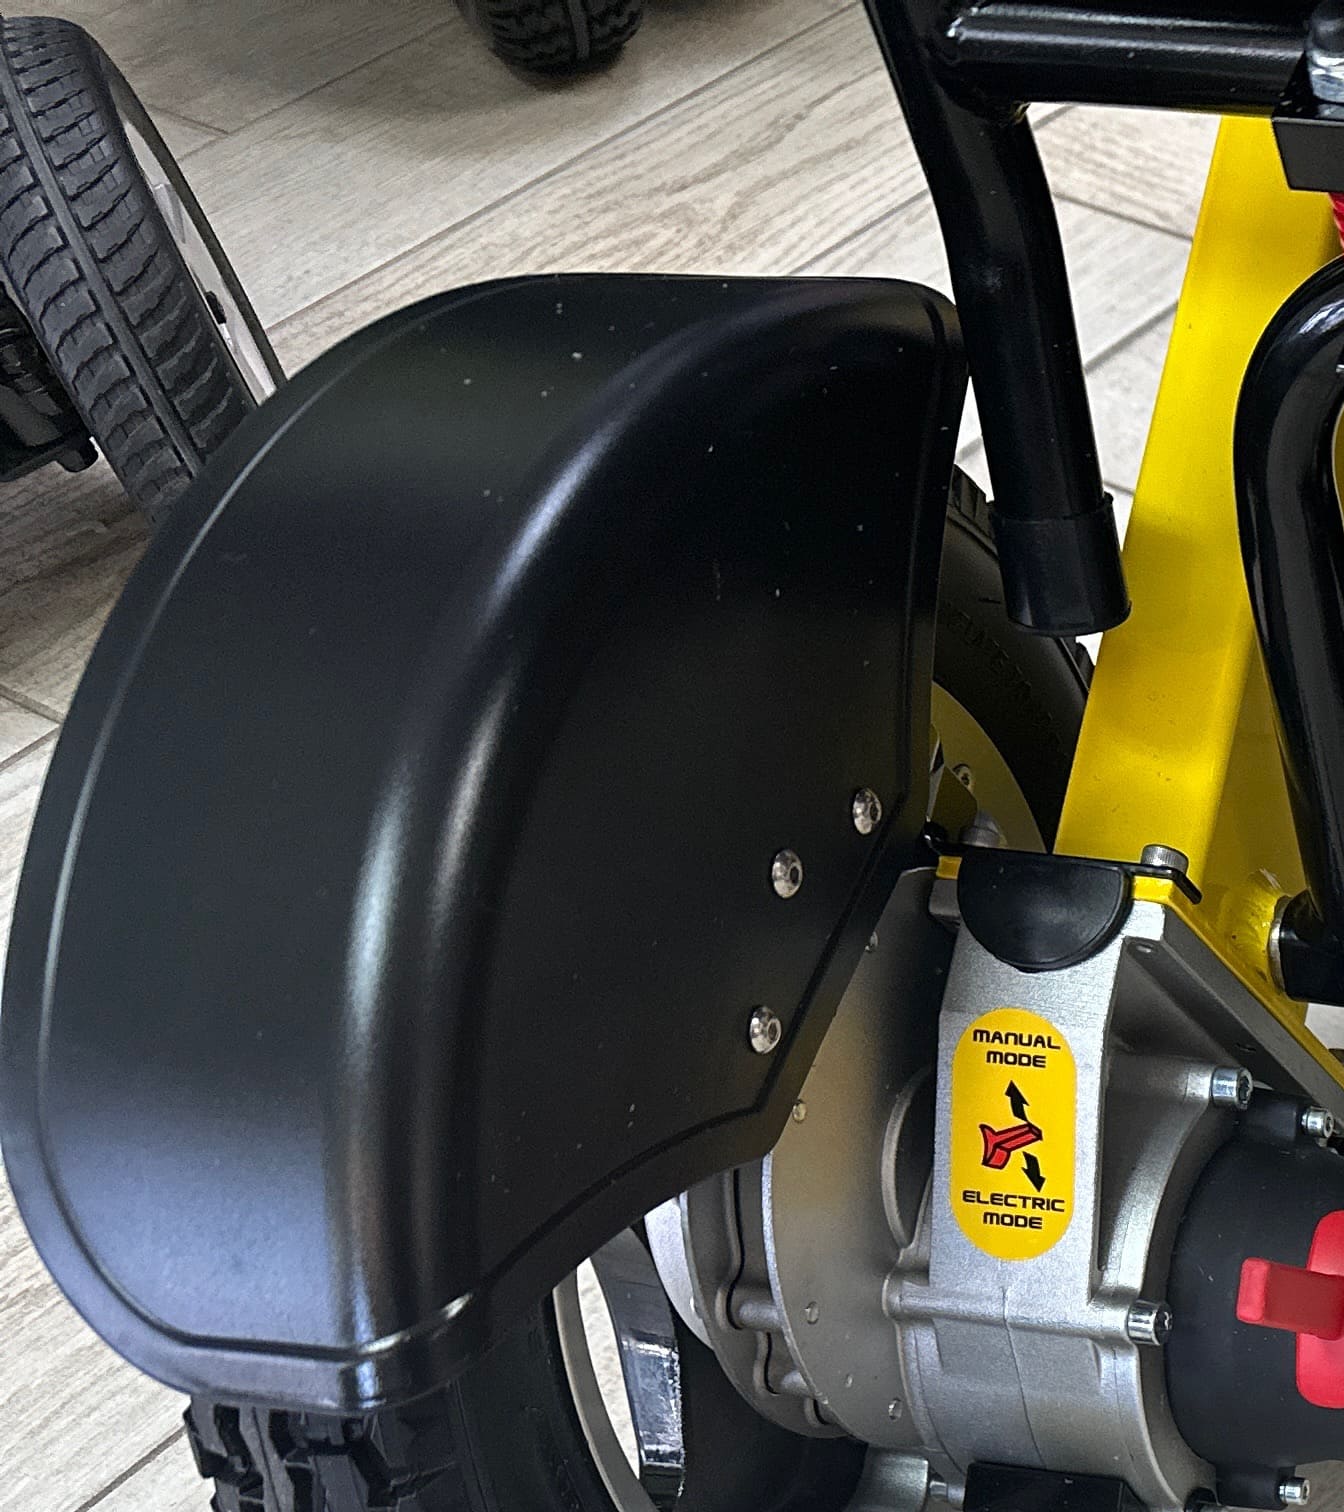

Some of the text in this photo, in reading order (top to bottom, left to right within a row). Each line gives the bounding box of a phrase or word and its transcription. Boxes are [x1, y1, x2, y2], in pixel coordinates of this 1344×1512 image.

[972, 1028, 1061, 1050] MANUAL
[986, 1050, 1046, 1068] MODE
[962, 1190, 1065, 1212] ELECTRIC
[983, 1211, 1043, 1229] MODE
